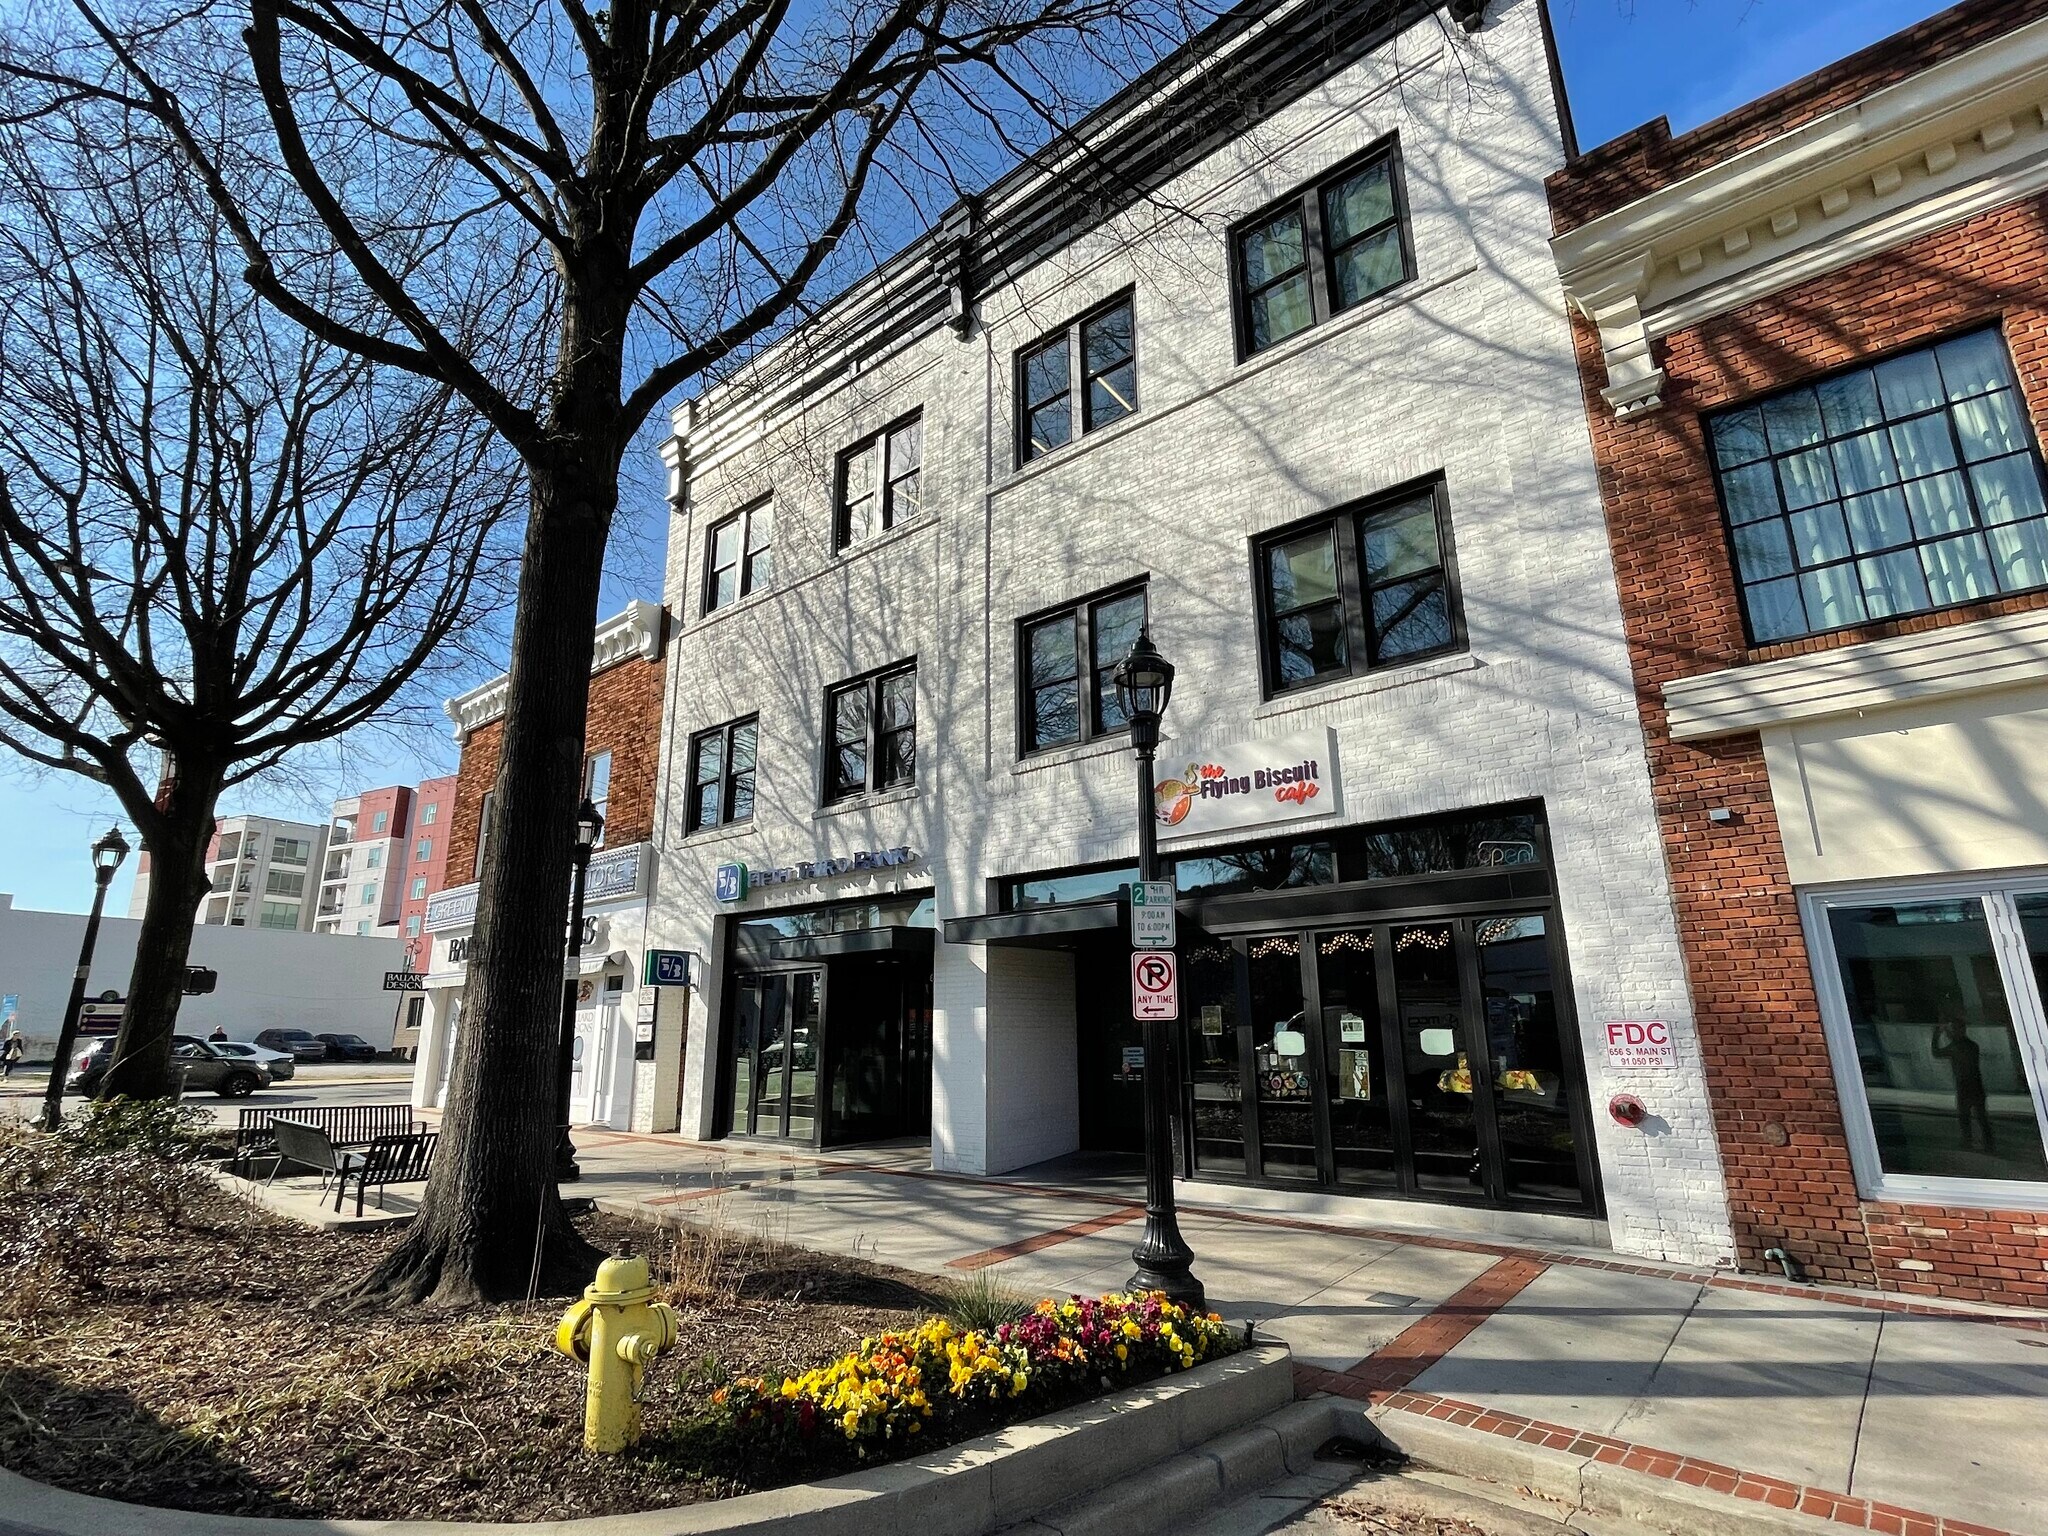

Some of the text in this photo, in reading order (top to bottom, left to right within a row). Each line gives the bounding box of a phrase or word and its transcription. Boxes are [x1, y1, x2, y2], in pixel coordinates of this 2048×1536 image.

[1200, 763, 1226, 779] the
[1200, 760, 1319, 799] Flying Biscuit
[1274, 781, 1321, 806] cafe
[853, 846, 912, 870] BANK
[1478, 848, 1531, 868] open
[587, 862, 626, 888] TORE
[1134, 887, 1143, 903] 2
[1152, 886, 1164, 894] HR
[1145, 896, 1172, 904] PARKING
[1137, 923, 1145, 931] TO
[1137, 995, 1174, 1004] ANY TIME
[1607, 1022, 1668, 1045] FDC
[1609, 1048, 1623, 1056] 656
[1636, 1047, 1658, 1056] MAIN
[1661, 1047, 1672, 1056] ST
[1648, 1057, 1664, 1066] PSI
